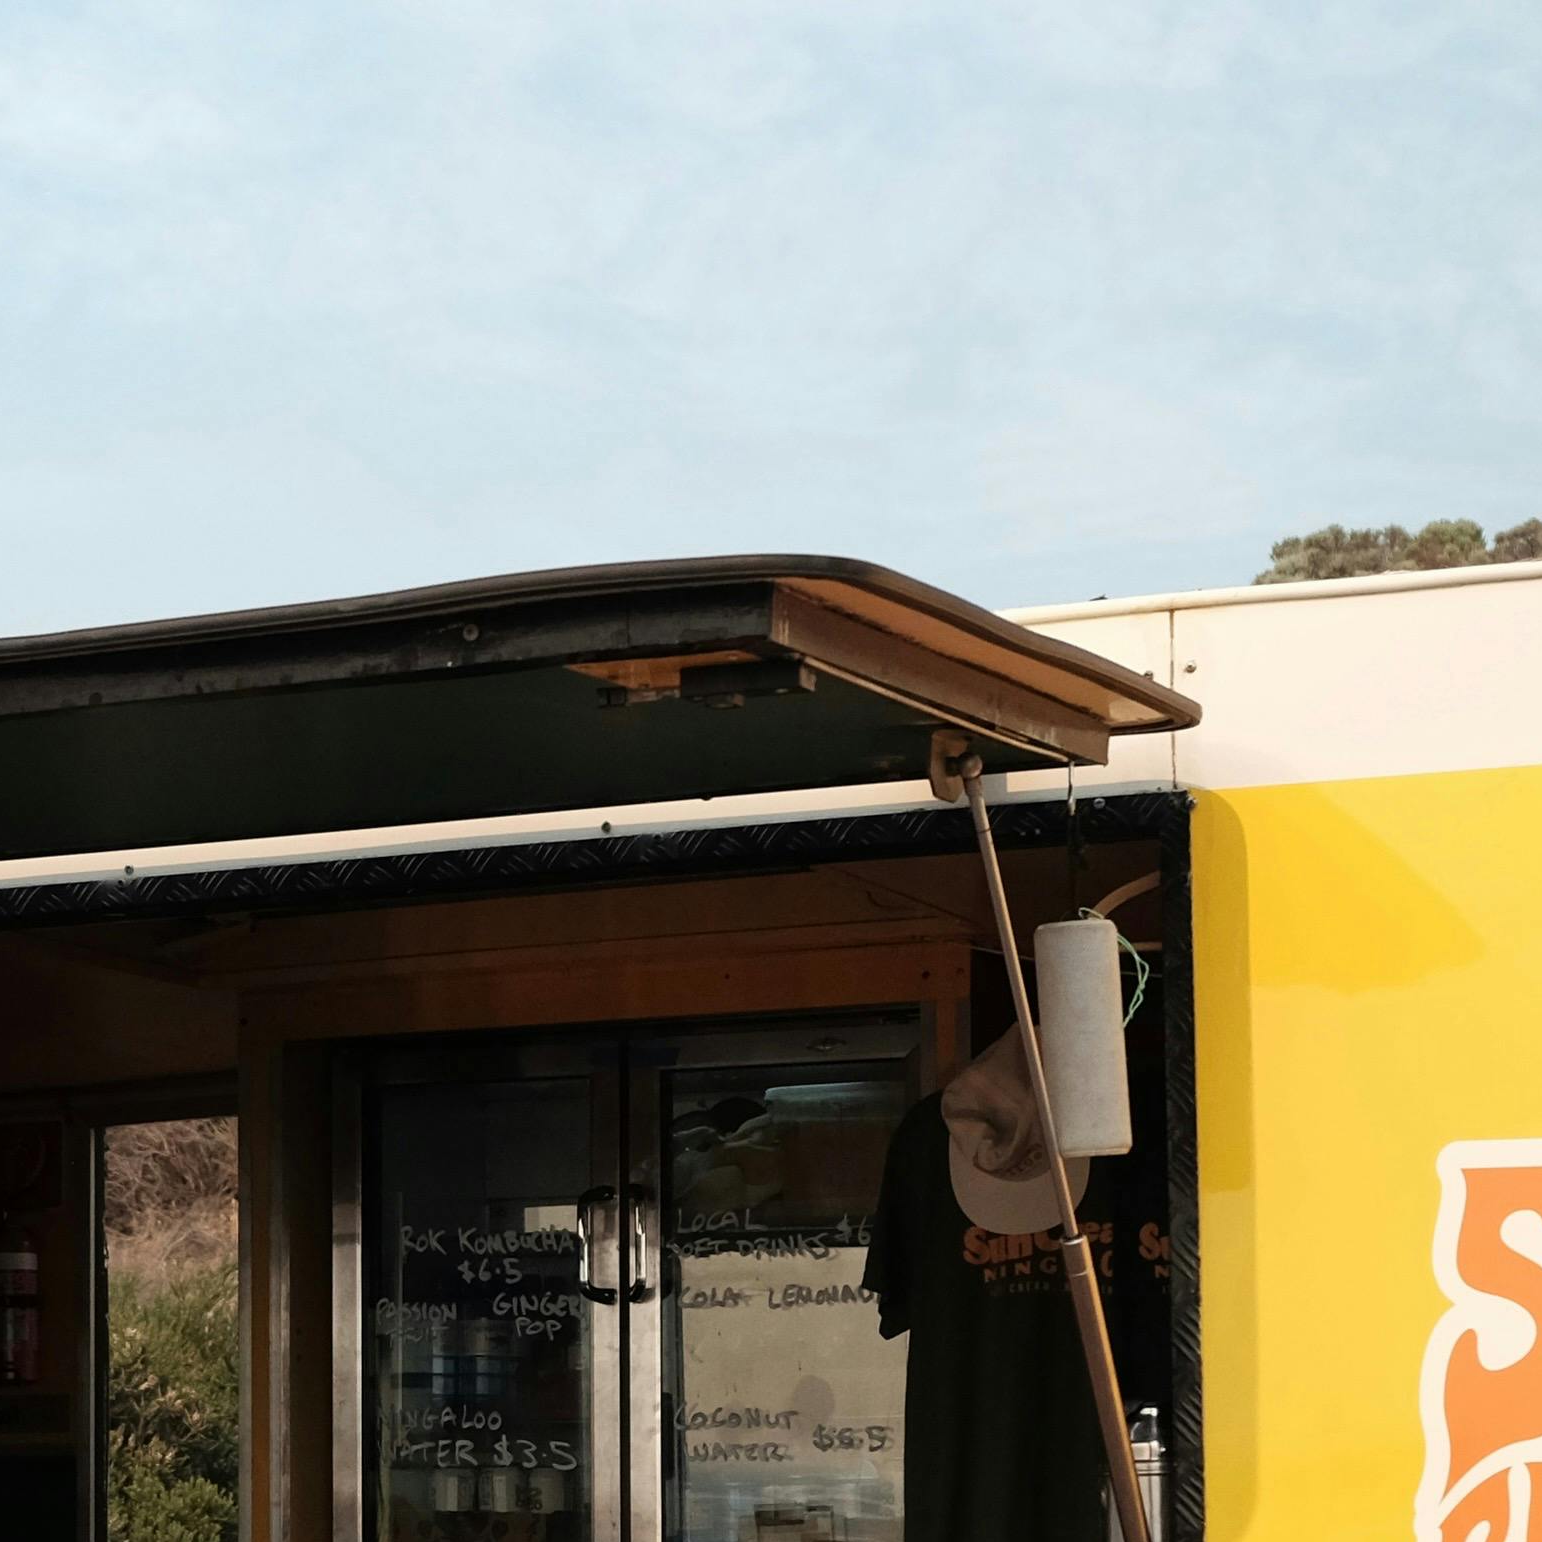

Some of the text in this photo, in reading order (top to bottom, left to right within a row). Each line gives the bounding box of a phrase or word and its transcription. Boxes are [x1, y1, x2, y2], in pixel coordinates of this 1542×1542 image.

[677, 1207, 768, 1233] LOCAL
[458, 1226, 575, 1256] KOMBUCHA
[768, 1284, 880, 1309] LEMONAD
[514, 1316, 563, 1342] POP
[674, 1407, 799, 1430] COCONUT
[685, 1442, 787, 1462] WATER
